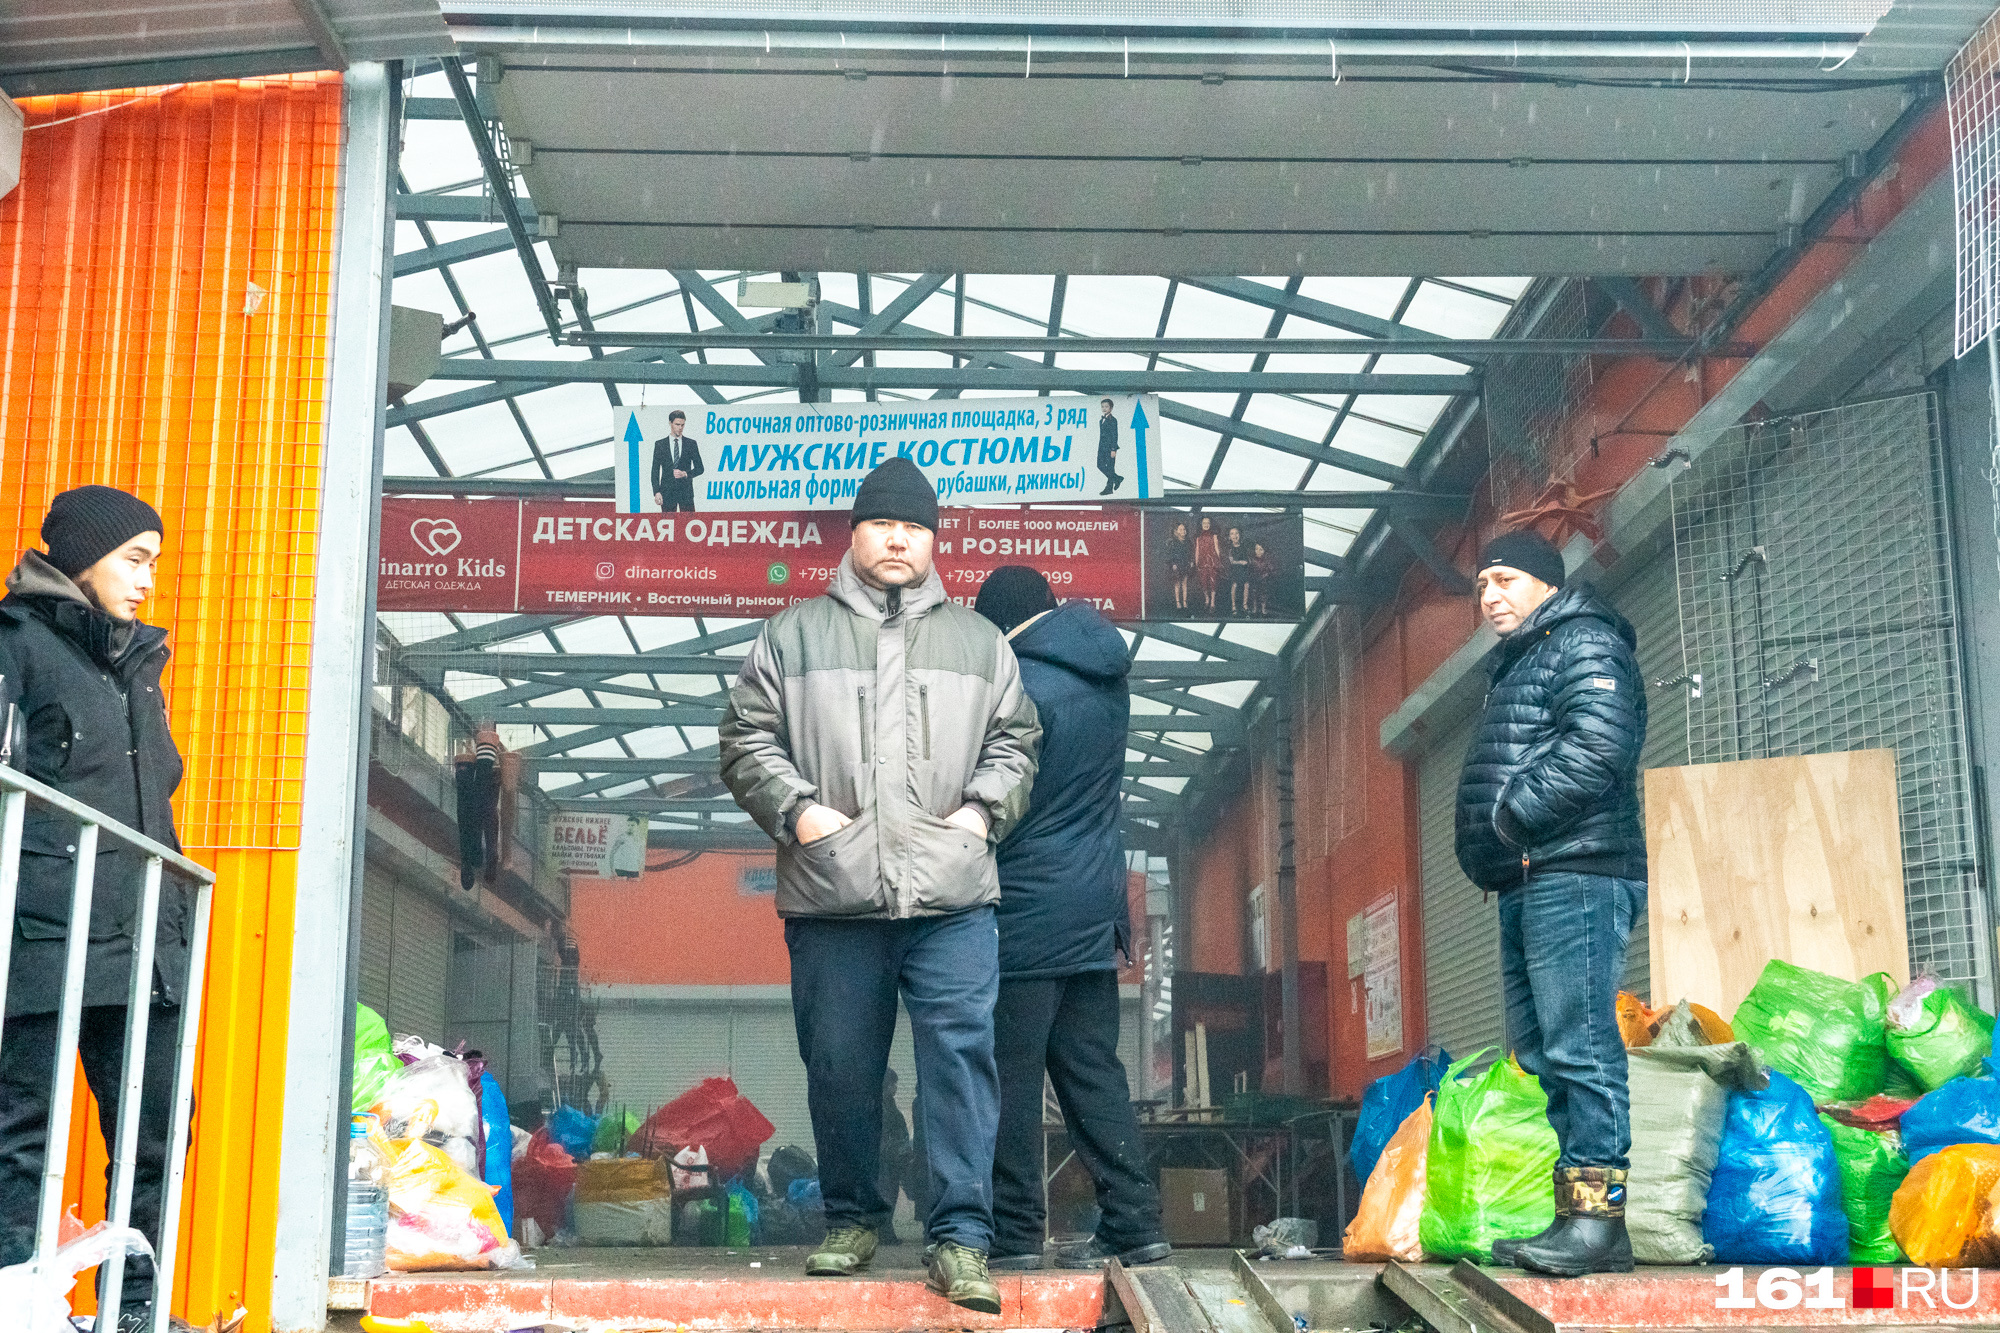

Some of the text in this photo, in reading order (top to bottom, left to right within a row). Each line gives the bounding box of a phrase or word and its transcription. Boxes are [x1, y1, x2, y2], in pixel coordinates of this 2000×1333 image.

[705, 404, 1087, 437] Восточная оптово-розничная площадка, 3 ряд
[717, 441, 887, 472] МУЖСКИЕ
[706, 479, 800, 500] школьная
[937, 470, 1012, 499] рубашки,
[1015, 466, 1086, 495] джинсы)
[532, 517, 822, 548] ДЕТСКАЯ ОДЕЖДА
[978, 519, 1119, 532] БОЛЕЕ 1000 МОДЕЛЕЙ
[962, 537, 1090, 558] РОЗНИЦА
[380, 557, 506, 577] inarro Kids
[625, 565, 717, 580] dinarrokids
[385, 580, 482, 590] ДЕТСКАЯ ОДЕЖДА
[546, 590, 632, 603] ТЕМЕРНИК
[648, 592, 732, 606] Восточный
[736, 596, 785, 608] рынок
[554, 824, 608, 845] БЕЛЬЁ
